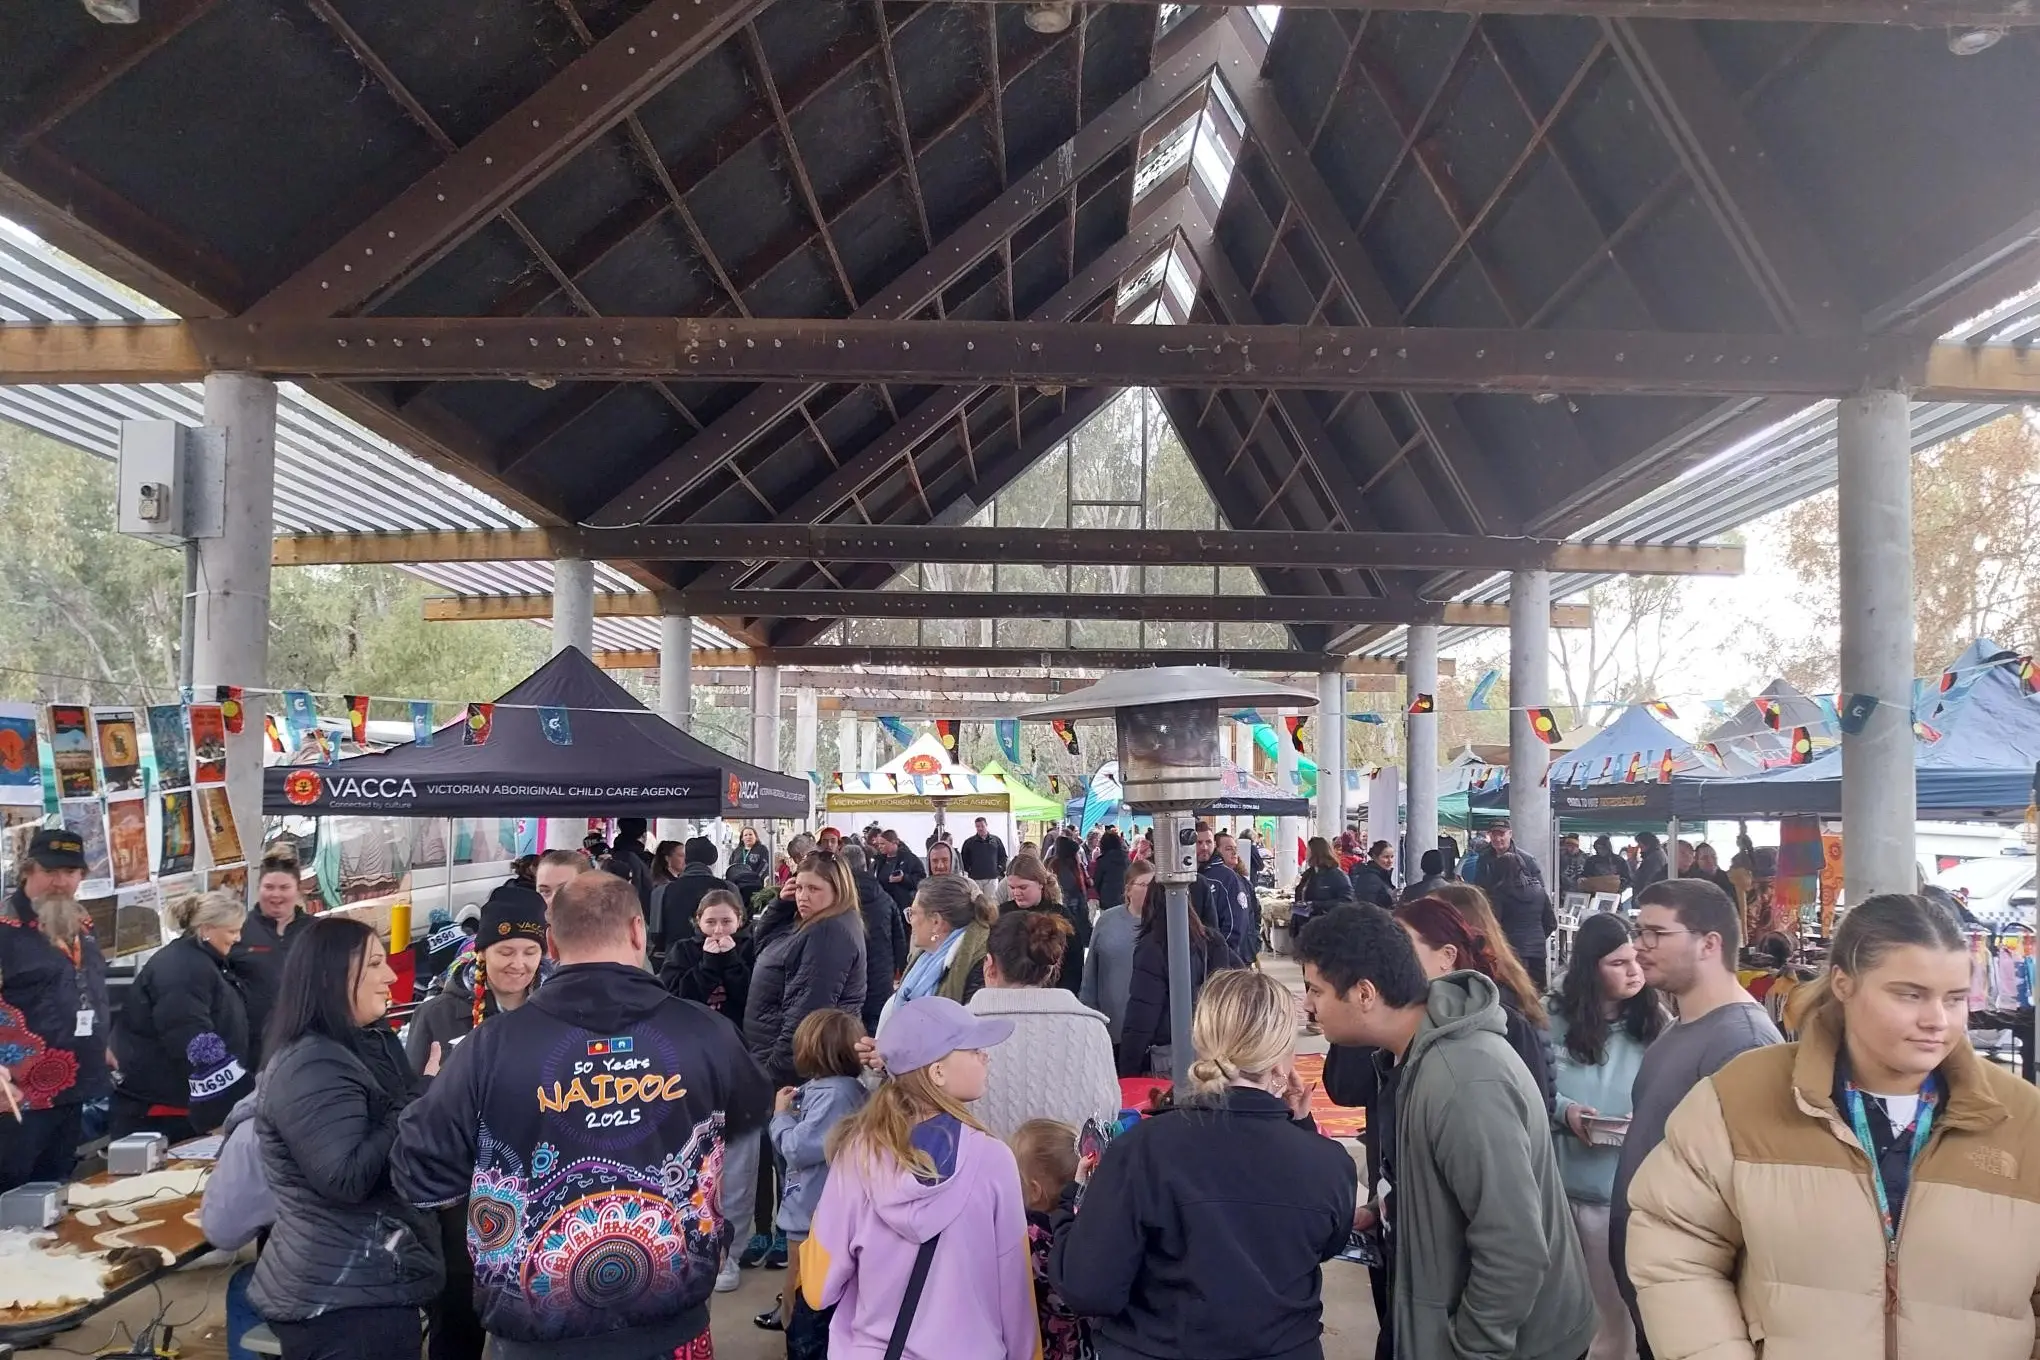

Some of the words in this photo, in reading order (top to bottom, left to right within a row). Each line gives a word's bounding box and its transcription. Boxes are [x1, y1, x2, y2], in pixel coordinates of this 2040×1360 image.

[325, 777, 417, 798] VACCA
[427, 784, 490, 795] VICTORIAN
[492, 785, 565, 796] ABORIGINAL
[568, 786, 603, 797] CHILD
[606, 787, 638, 797] CARE
[640, 786, 690, 797] AGENCY
[329, 800, 372, 808] Connected
[373, 801, 382, 810] by
[384, 801, 412, 809] culture
[834, 798, 875, 806] VICTORIAN
[876, 798, 922, 806] ABORIGINAL
[573, 1061, 594, 1075] 50
[602, 1057, 650, 1072] Years
[536, 1073, 688, 1113] NAIDOC
[585, 1108, 642, 1129] 2025
